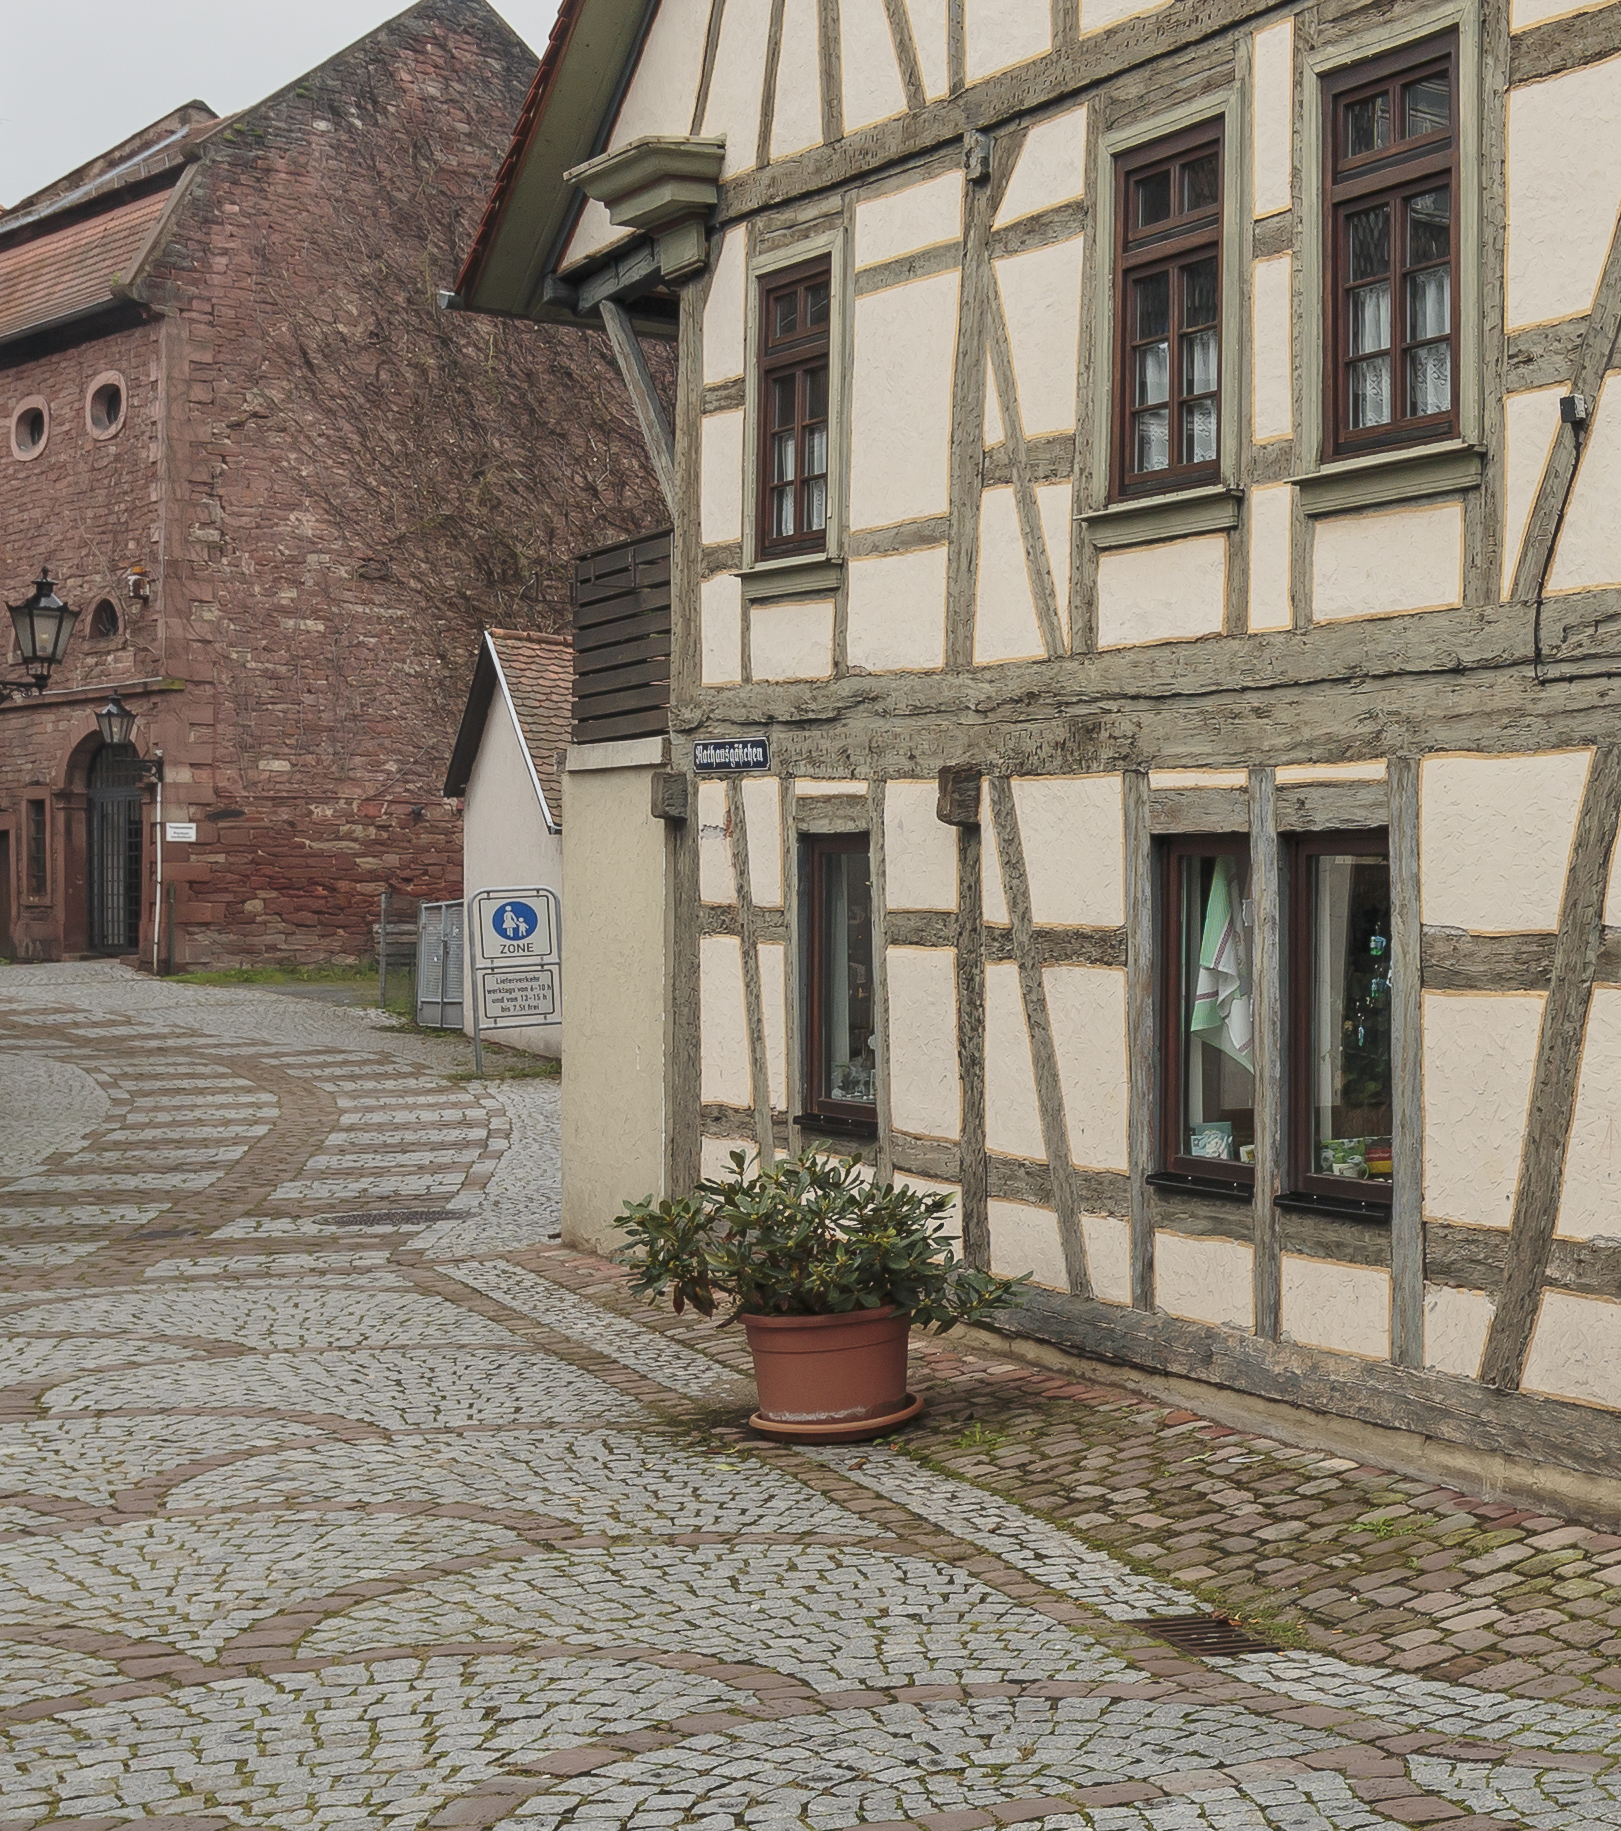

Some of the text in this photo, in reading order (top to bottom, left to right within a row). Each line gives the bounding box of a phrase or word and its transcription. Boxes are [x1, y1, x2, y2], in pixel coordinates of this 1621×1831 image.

[500, 943, 534, 954] ZONE
[496, 975, 540, 985] Lieferverkehr
[487, 987, 515, 995] werktags
[530, 984, 545, 992] 6-10
